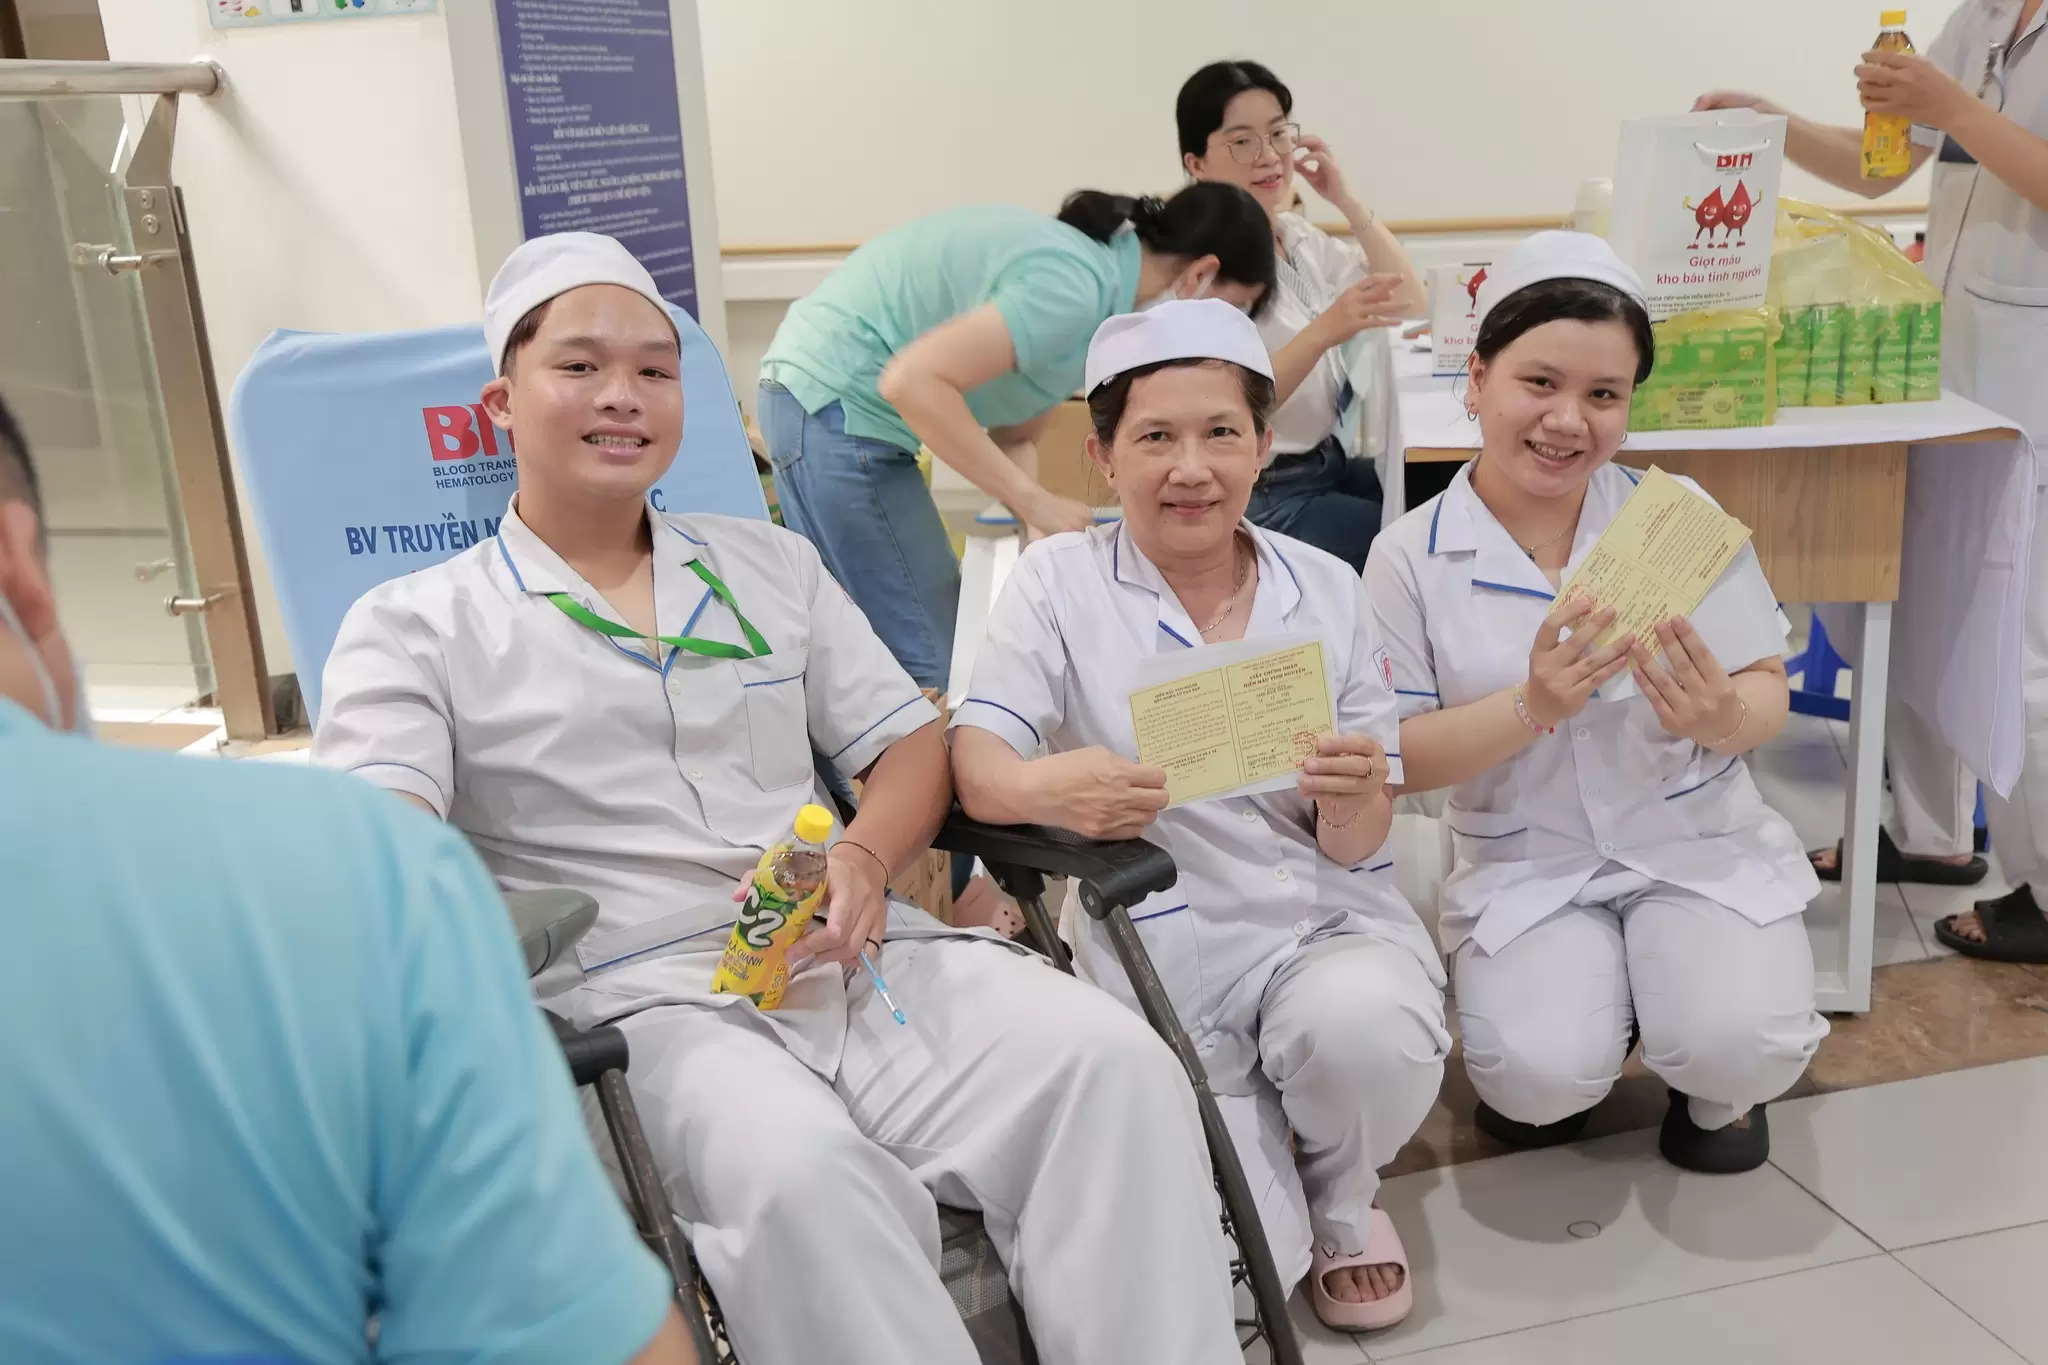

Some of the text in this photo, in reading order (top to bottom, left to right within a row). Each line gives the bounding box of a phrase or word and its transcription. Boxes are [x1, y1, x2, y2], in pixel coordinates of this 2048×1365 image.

[1689, 254, 1741, 269] Giọt máu
[1656, 273, 1679, 285] kho
[1683, 271, 1705, 284] báu
[1732, 264, 1761, 282] người
[1444, 336, 1464, 345] kho
[423, 403, 516, 461] BT
[432, 459, 517, 477] BLOOD TRANS
[435, 471, 514, 490] HEMATOLOGY
[345, 526, 377, 555] BV
[383, 512, 479, 553] TRUYỀN
